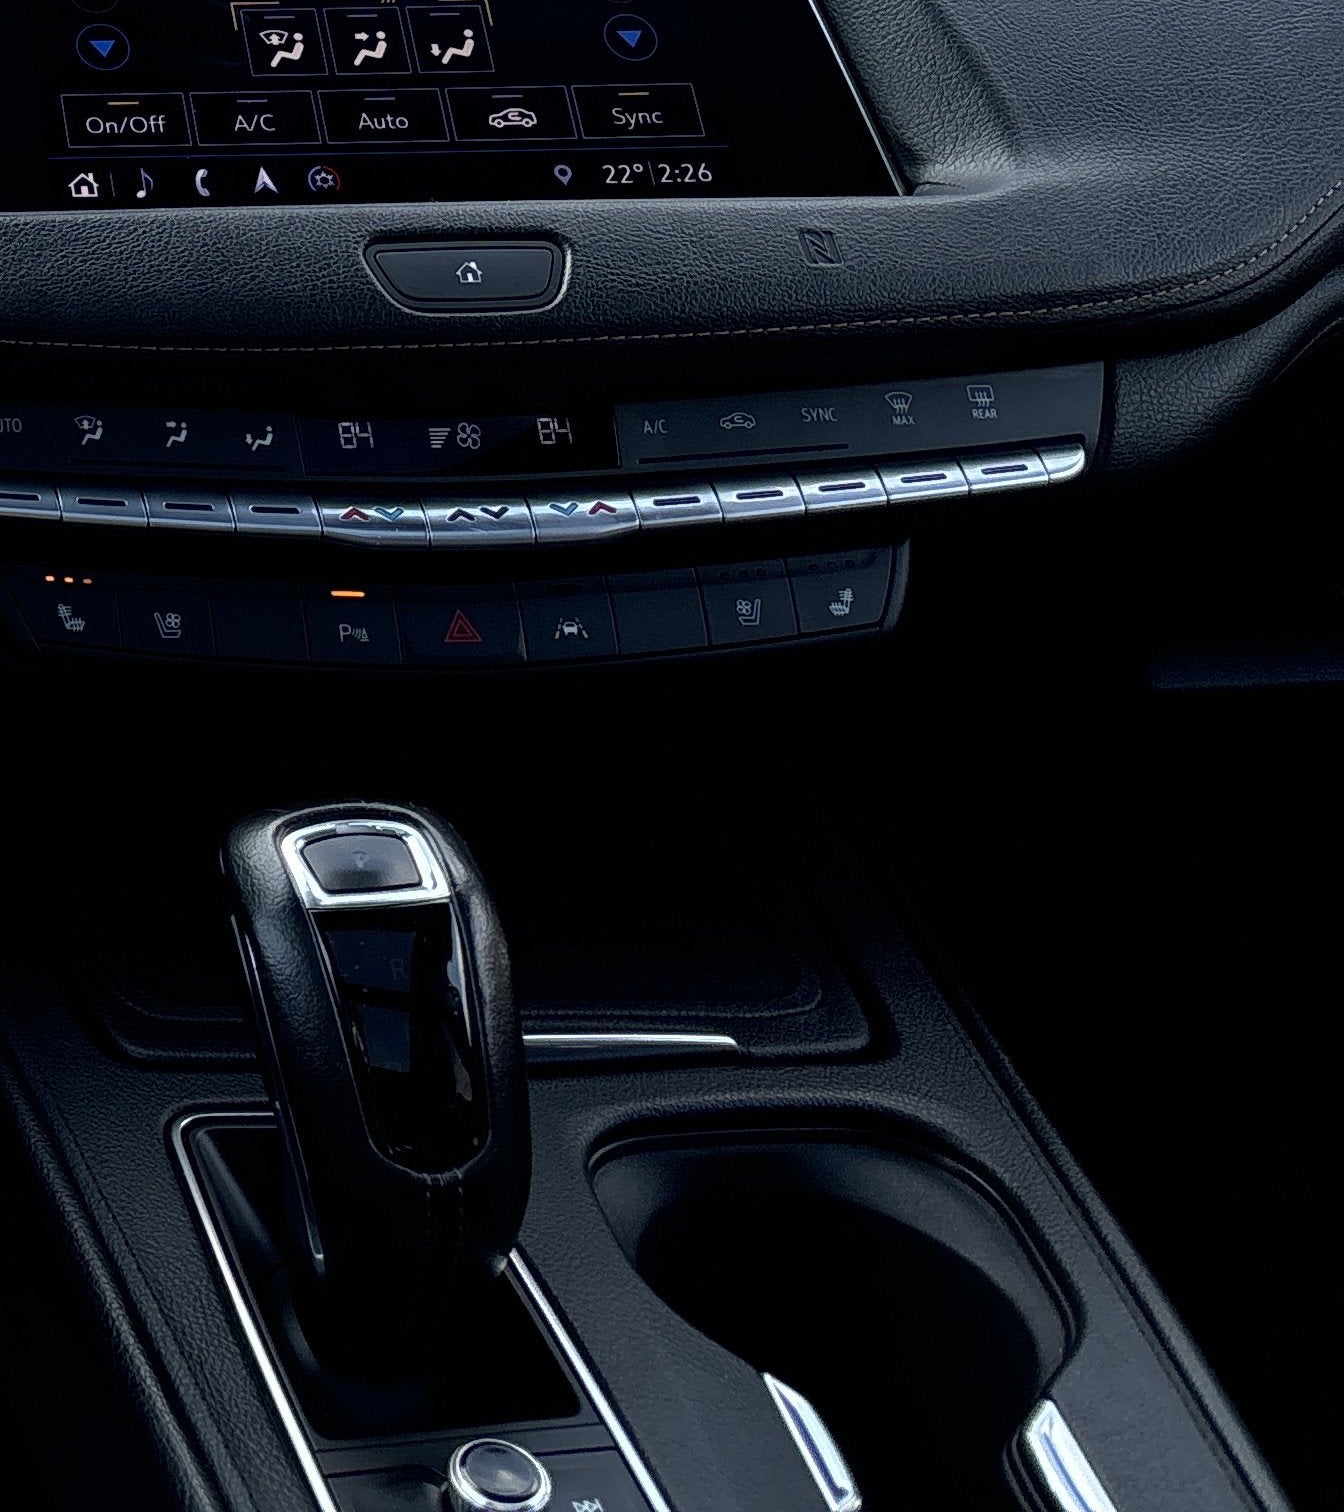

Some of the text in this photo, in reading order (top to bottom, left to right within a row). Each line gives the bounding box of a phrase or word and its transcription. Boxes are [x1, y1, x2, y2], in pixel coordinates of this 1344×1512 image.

[85, 113, 167, 134] On/Off
[234, 113, 276, 132] A/C
[358, 112, 409, 130] Auto
[611, 107, 664, 130] Sync
[657, 161, 713, 183] 2:26
[801, 406, 839, 423] SYNC
[891, 415, 915, 425] MAX
[972, 407, 998, 419] REAR
[337, 421, 375, 449] 84
[537, 417, 573, 445] 84
[643, 418, 669, 435] A/C
